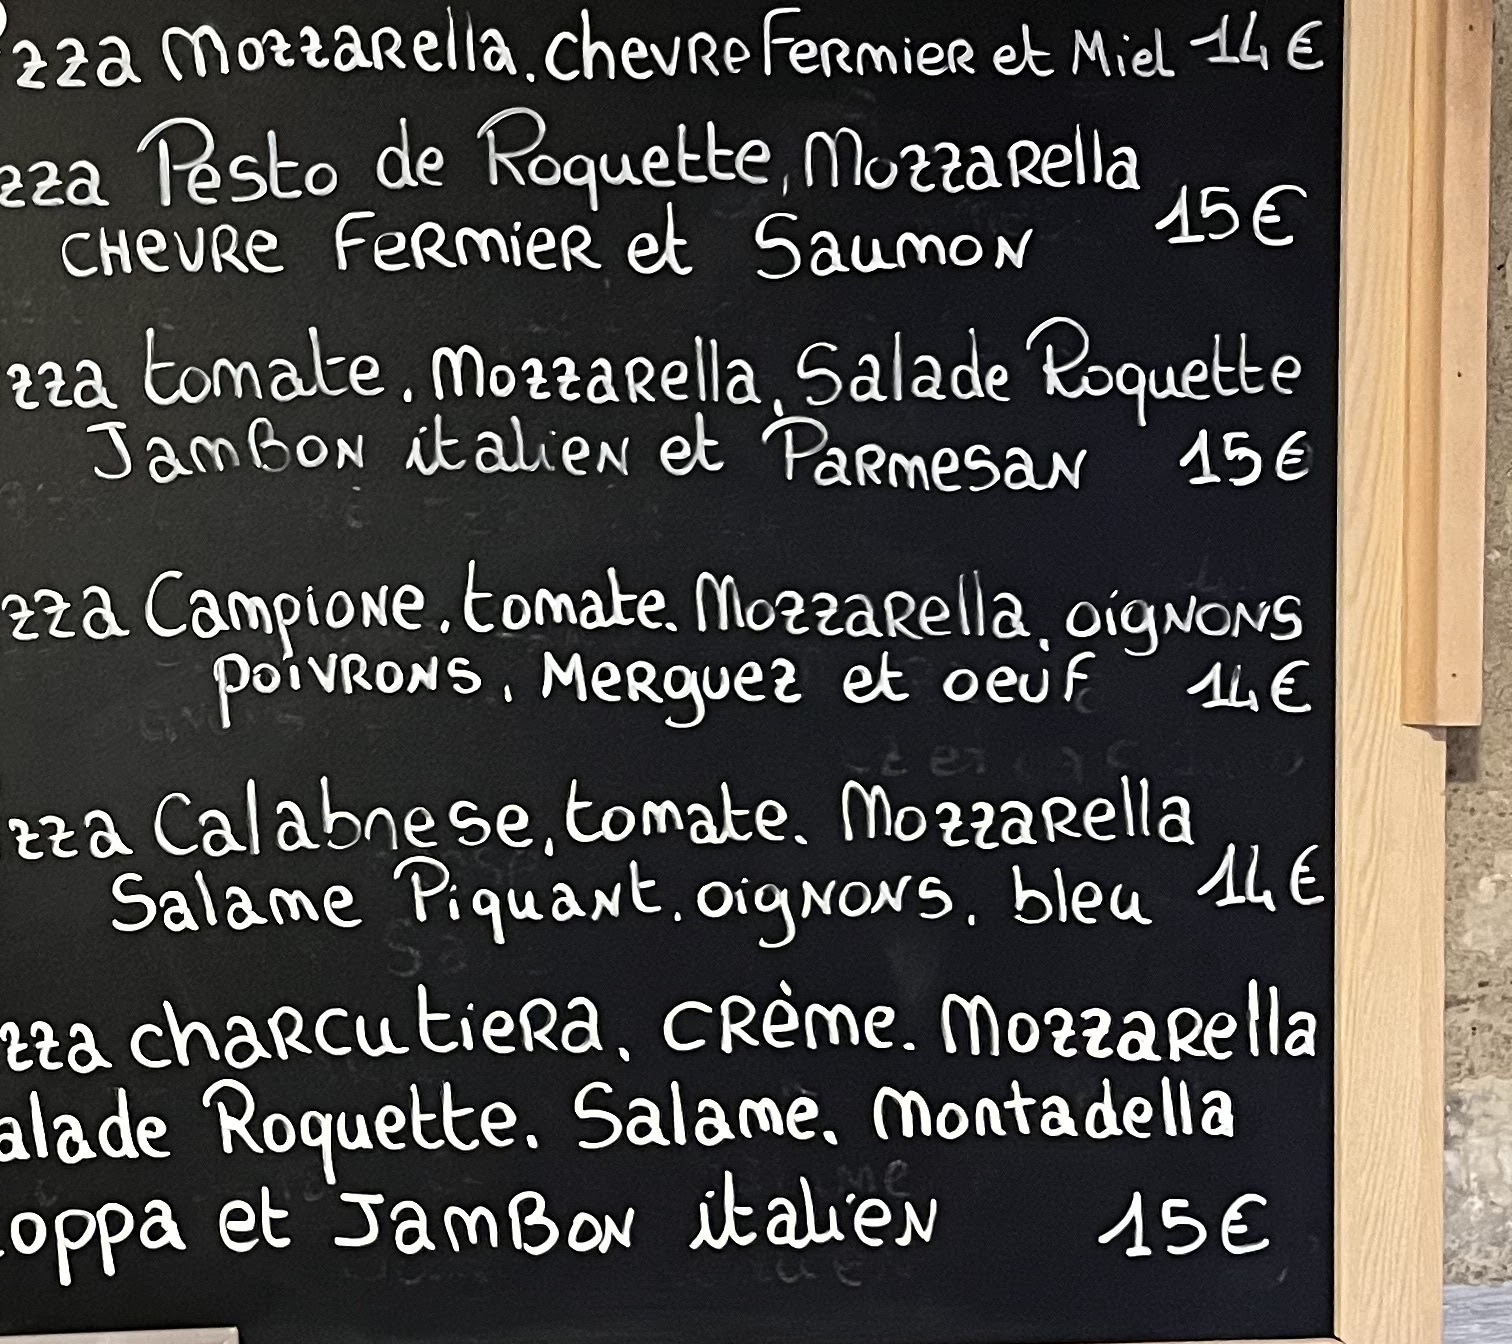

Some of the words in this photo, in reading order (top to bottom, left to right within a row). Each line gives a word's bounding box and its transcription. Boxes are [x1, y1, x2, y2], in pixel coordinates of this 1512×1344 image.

[991, 22, 1056, 79] et
[1070, 26, 1177, 79] Miel
[135, 115, 339, 208] Pesto
[375, 116, 446, 191] de
[625, 200, 695, 277] et
[795, 326, 1012, 407] Salade
[1024, 315, 1303, 429] Roquette
[658, 410, 726, 477] et
[841, 649, 911, 705] et
[941, 649, 1098, 705] oeuf
[110, 868, 364, 934] Salame
[1010, 863, 1154, 926] bleu
[217, 1184, 293, 1254] et
